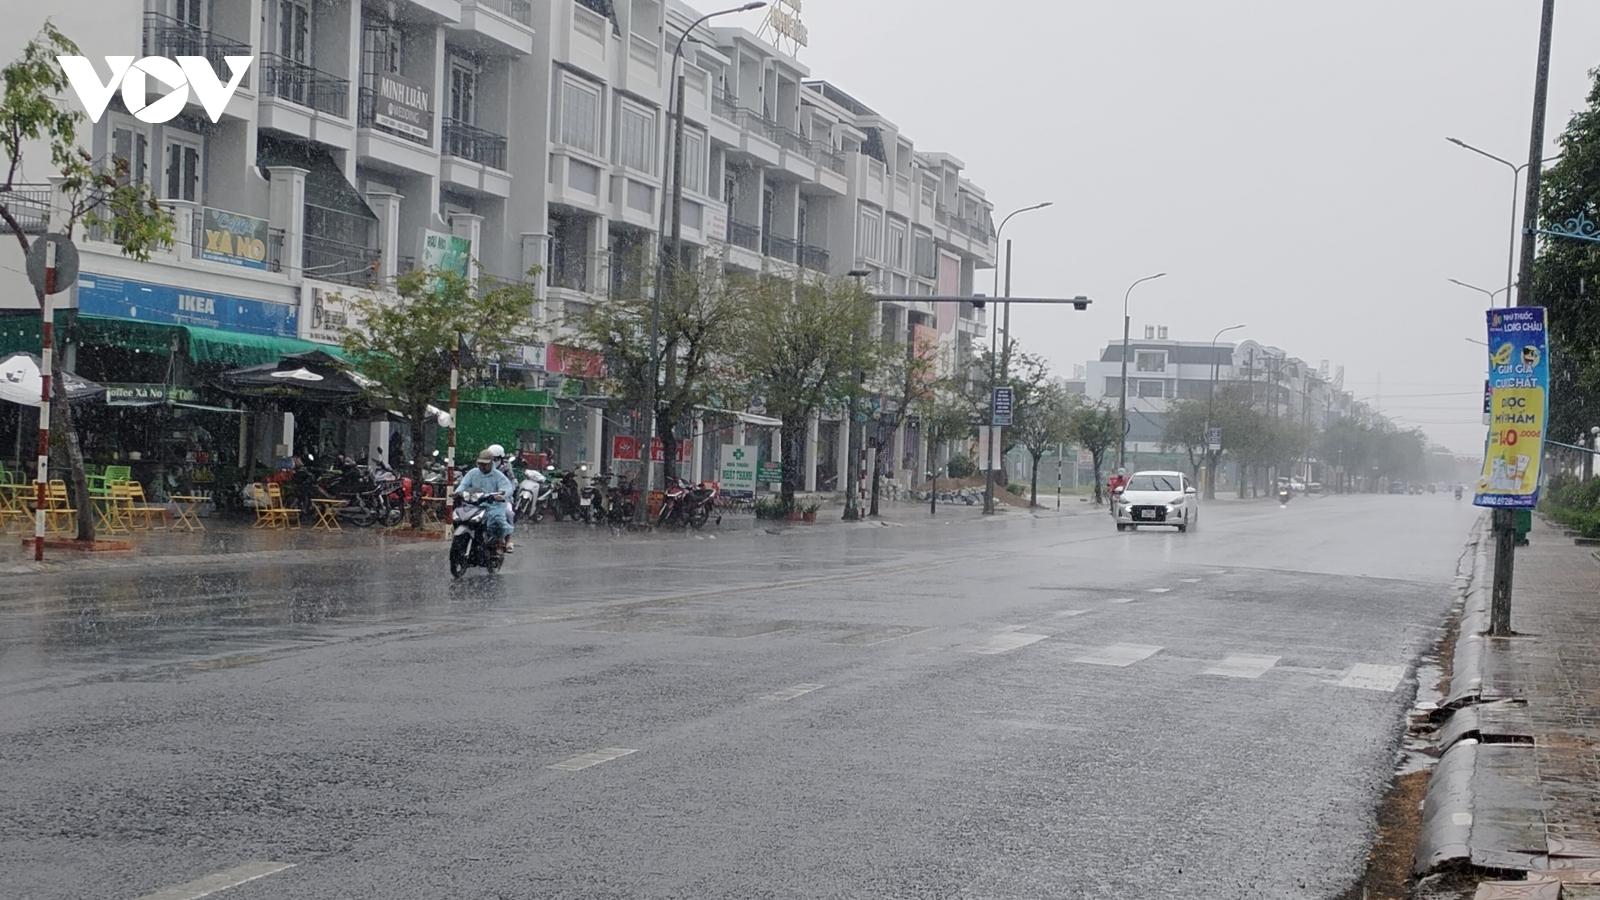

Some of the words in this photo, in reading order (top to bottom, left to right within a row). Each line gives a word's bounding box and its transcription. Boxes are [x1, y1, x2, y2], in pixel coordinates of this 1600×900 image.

[381, 77, 405, 104] MINH
[405, 86, 429, 112] LUÂN
[236, 235, 266, 262] NO
[178, 294, 216, 315] IKEA
[108, 387, 133, 397] offee
[150, 388, 162, 398] No
